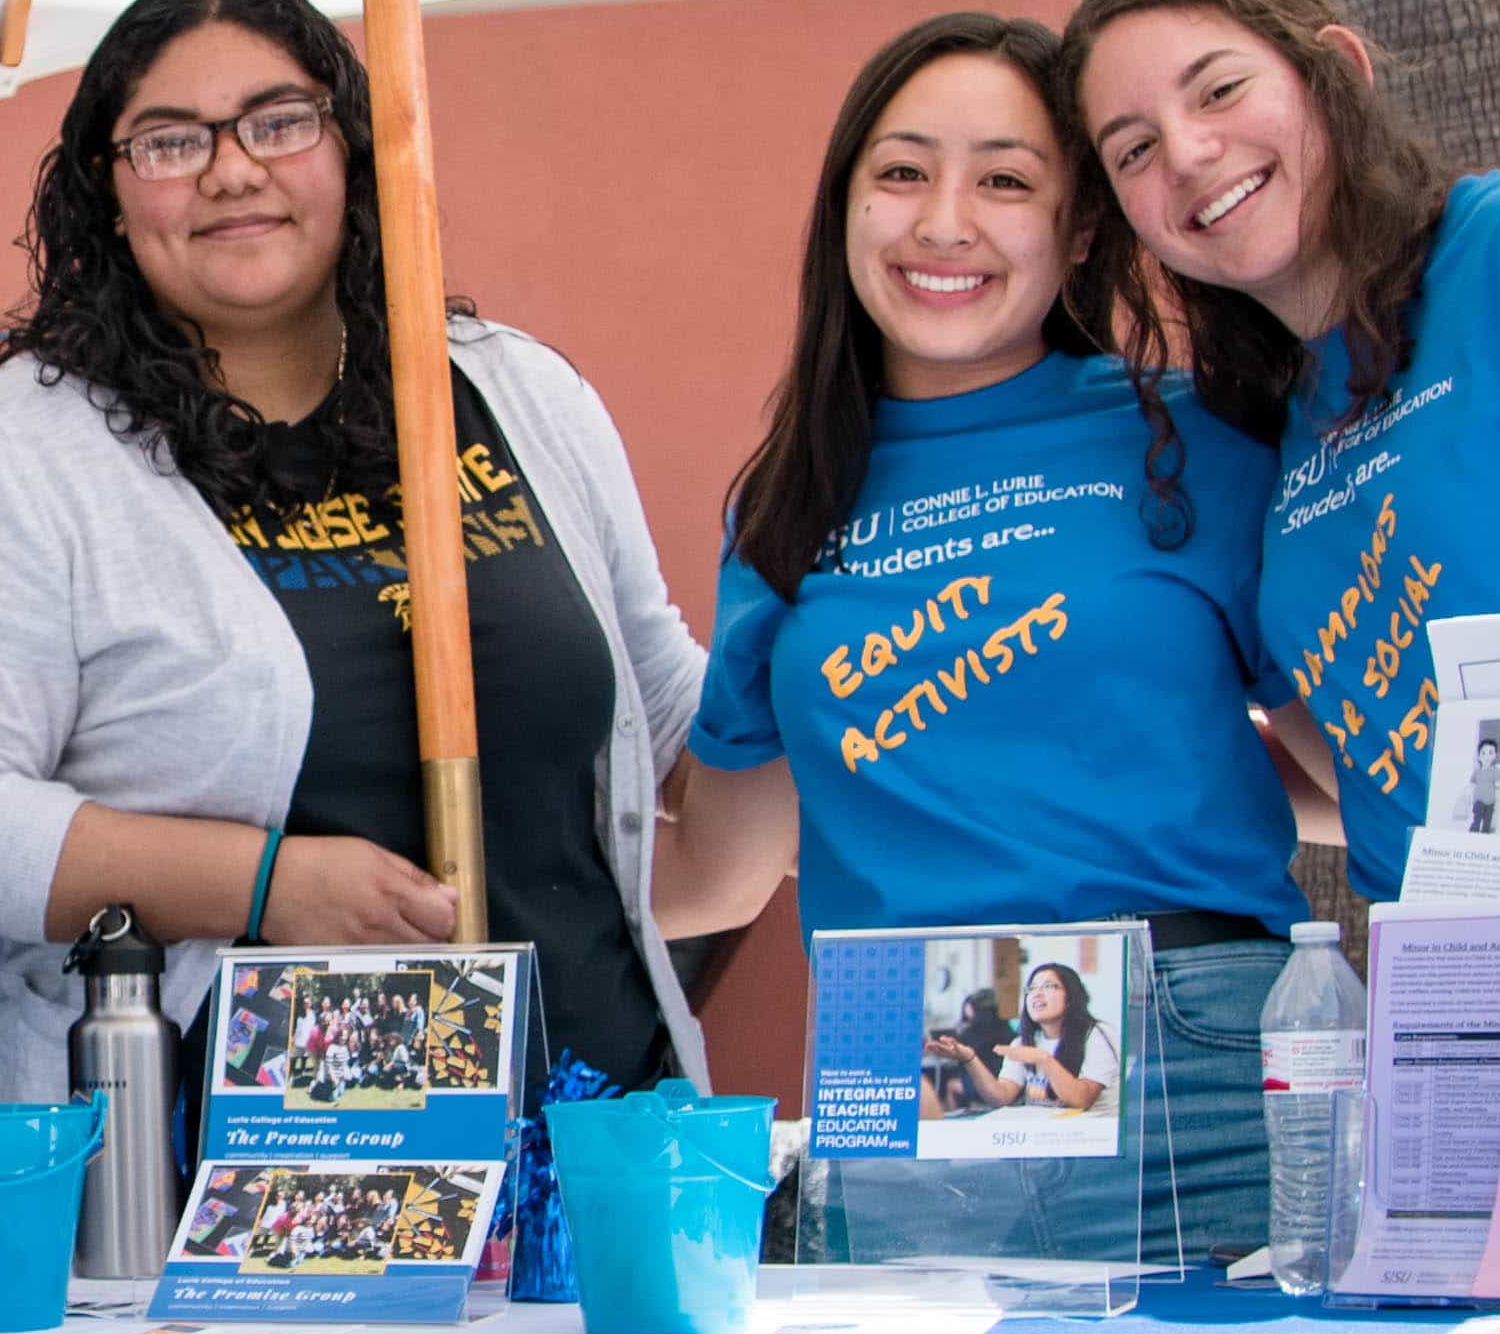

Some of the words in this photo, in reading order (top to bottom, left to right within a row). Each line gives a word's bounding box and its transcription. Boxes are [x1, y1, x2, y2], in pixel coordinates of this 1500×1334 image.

[901, 486, 972, 519] CONNIE
[974, 483, 990, 501] L.
[992, 473, 1046, 495] LURIE
[900, 502, 983, 534] COLLEGE
[984, 496, 1010, 515] OF
[1013, 480, 1125, 509] EDUCATION
[980, 521, 1056, 553] are...
[1362, 554, 1443, 699] SOCIAL
[820, 574, 993, 700] EQUITY
[840, 592, 1069, 773] ACTIVISTS
[1420, 846, 1451, 859] Minor
[1453, 848, 1463, 859] in
[1464, 850, 1490, 862] Child
[1402, 941, 1430, 953] Minor
[1431, 942, 1441, 953] in
[1443, 941, 1468, 953] Child
[1469, 942, 1488, 952] and
[818, 1086, 917, 1102] INTEGRATED
[816, 1102, 891, 1118] TEACHER
[816, 1118, 898, 1134] EDUCATION
[226, 1127, 261, 1146] The
[264, 1129, 341, 1146] Promise
[345, 1130, 406, 1149] Group
[816, 1134, 889, 1149] PROGRAM
[992, 1130, 1027, 1147] SJSU
[172, 1286, 205, 1301] The
[211, 1288, 291, 1302] Promise
[294, 1289, 357, 1304] Group
